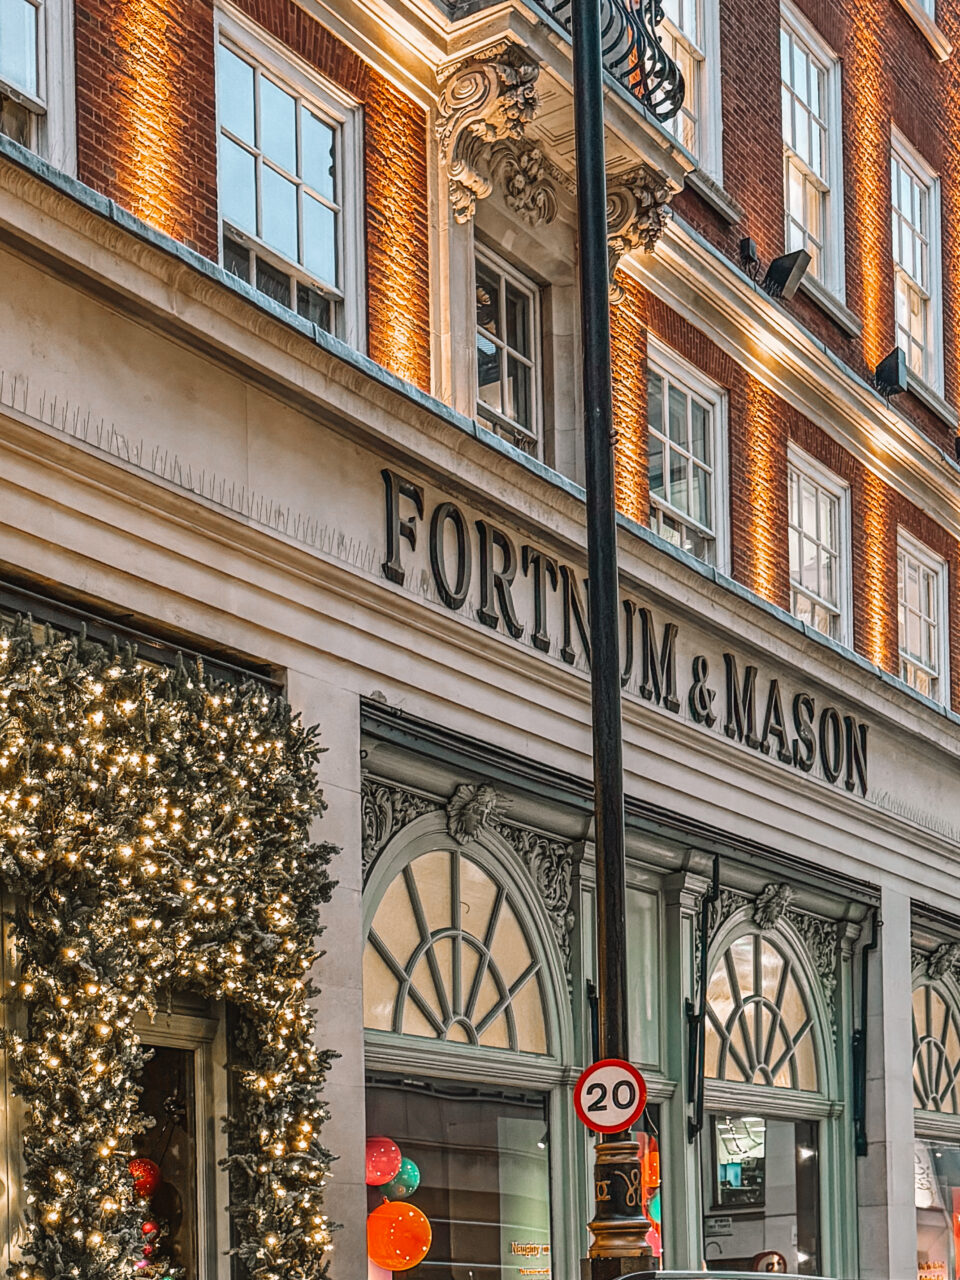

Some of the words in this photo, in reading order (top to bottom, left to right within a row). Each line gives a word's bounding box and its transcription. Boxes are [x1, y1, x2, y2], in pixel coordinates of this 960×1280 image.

[689, 655, 717, 728] &
[723, 653, 870, 799] MASON
[586, 1080, 636, 1113] 20
